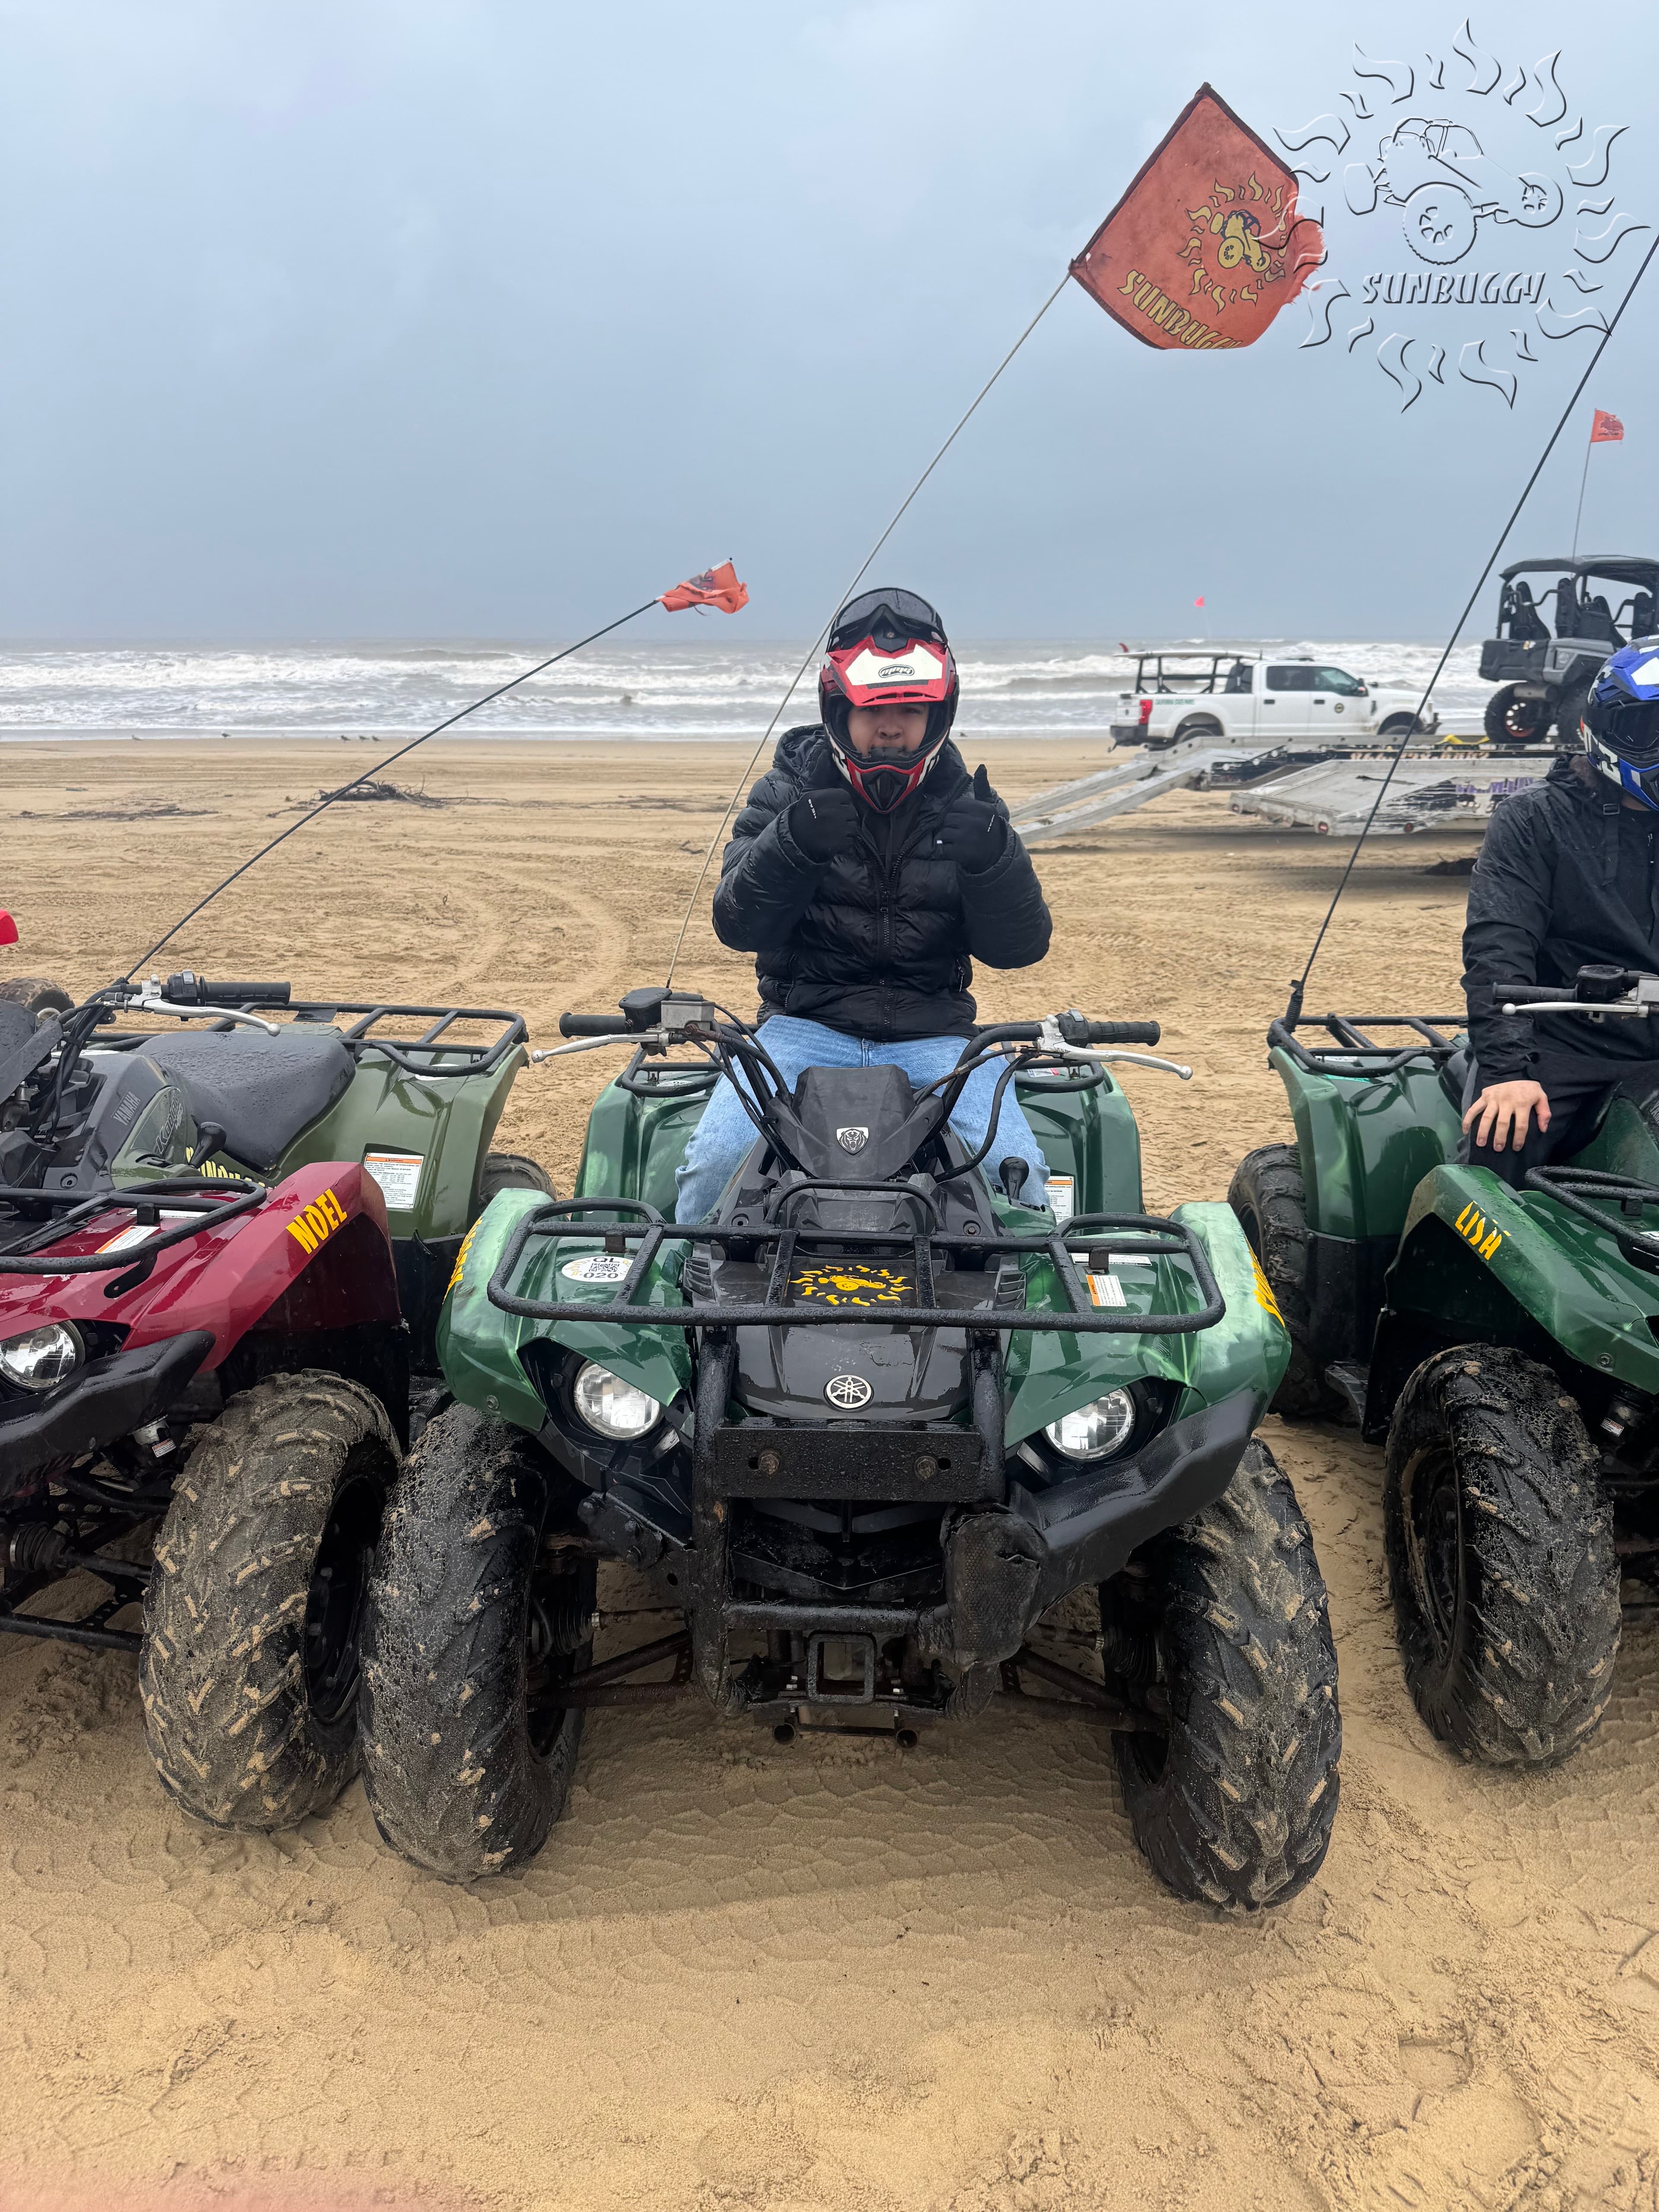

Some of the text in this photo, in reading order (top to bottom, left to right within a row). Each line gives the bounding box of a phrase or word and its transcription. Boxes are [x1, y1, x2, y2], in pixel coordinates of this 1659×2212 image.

[113, 1091, 141, 1126] YAMAHA
[286, 1189, 347, 1254] NOEL
[1455, 1200, 1512, 1261] LISA
